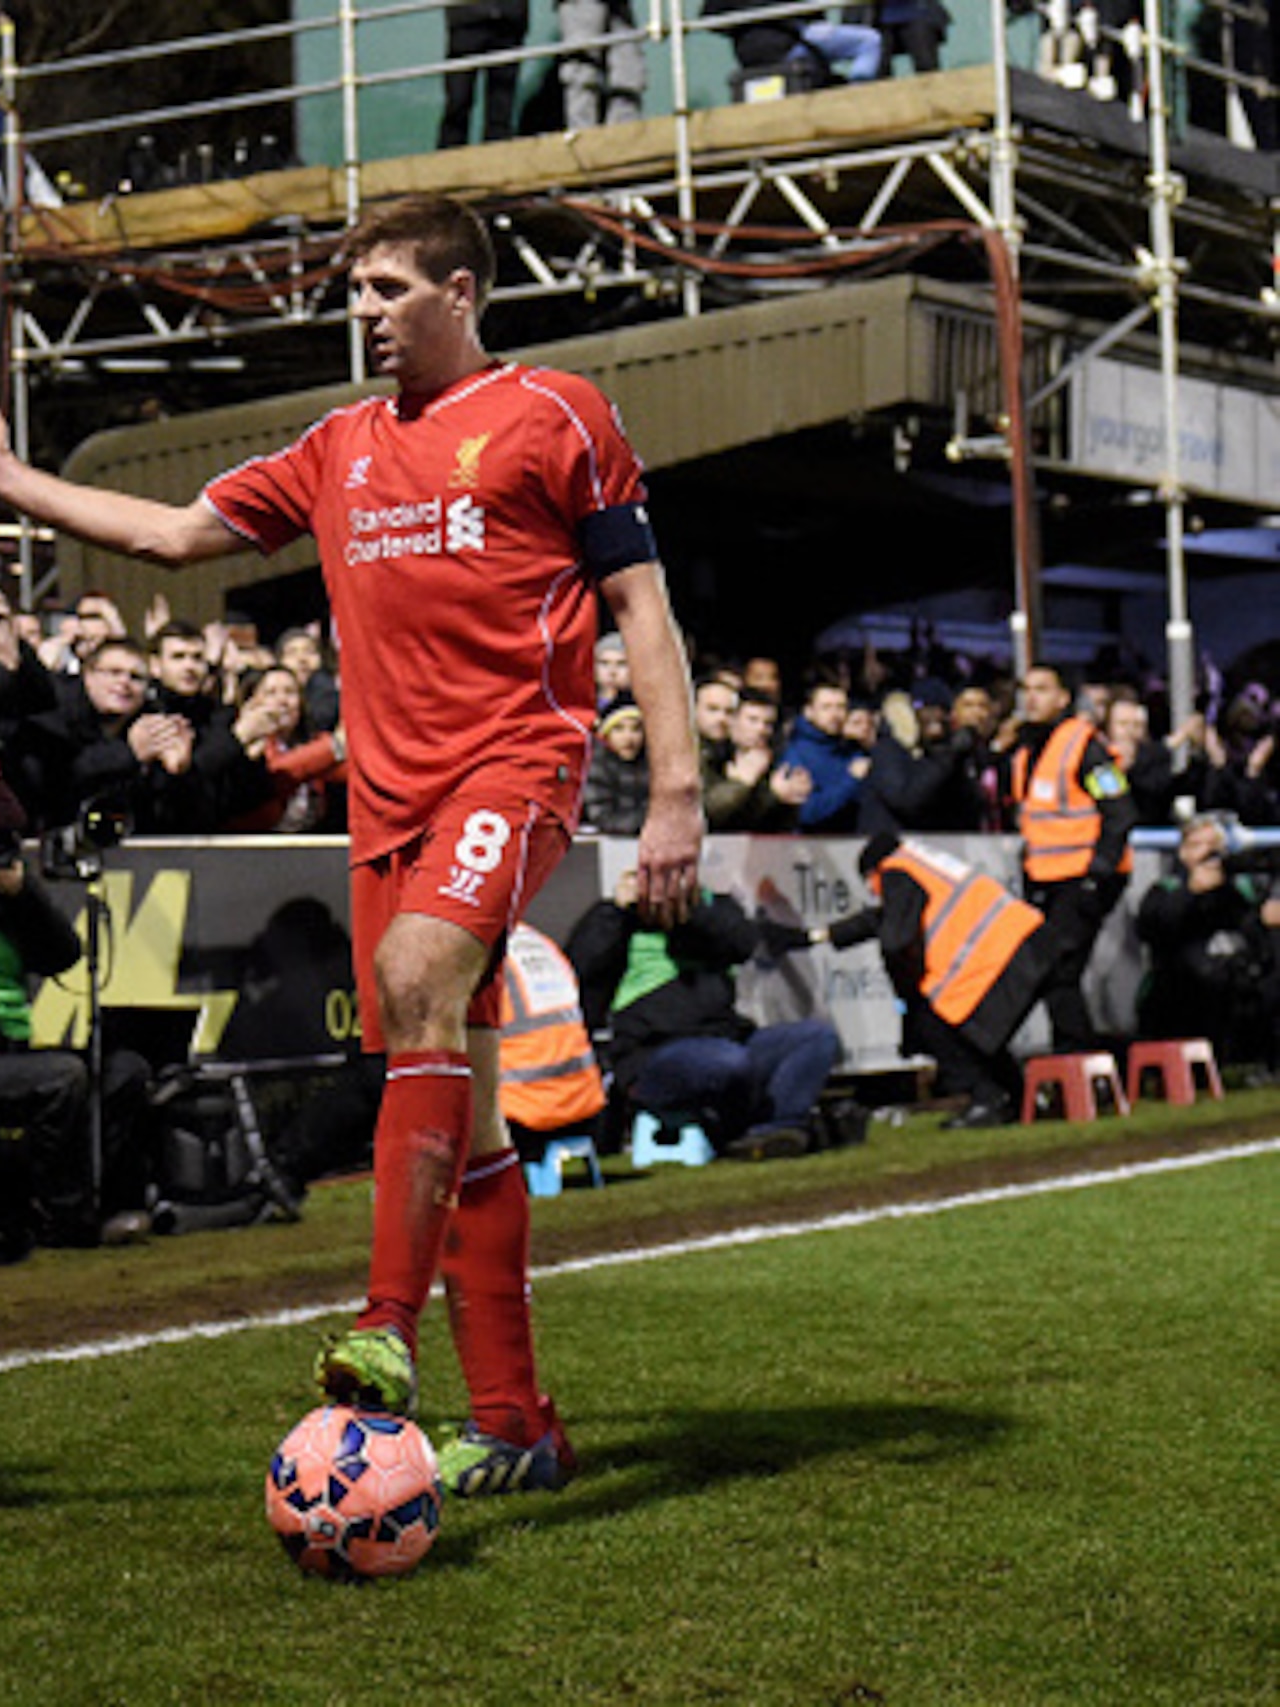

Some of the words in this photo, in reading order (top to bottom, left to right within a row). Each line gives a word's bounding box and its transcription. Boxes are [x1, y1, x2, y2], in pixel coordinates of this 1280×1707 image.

[343, 526, 442, 567] Chartered
[455, 808, 511, 873] 8
[793, 862, 851, 914] The
